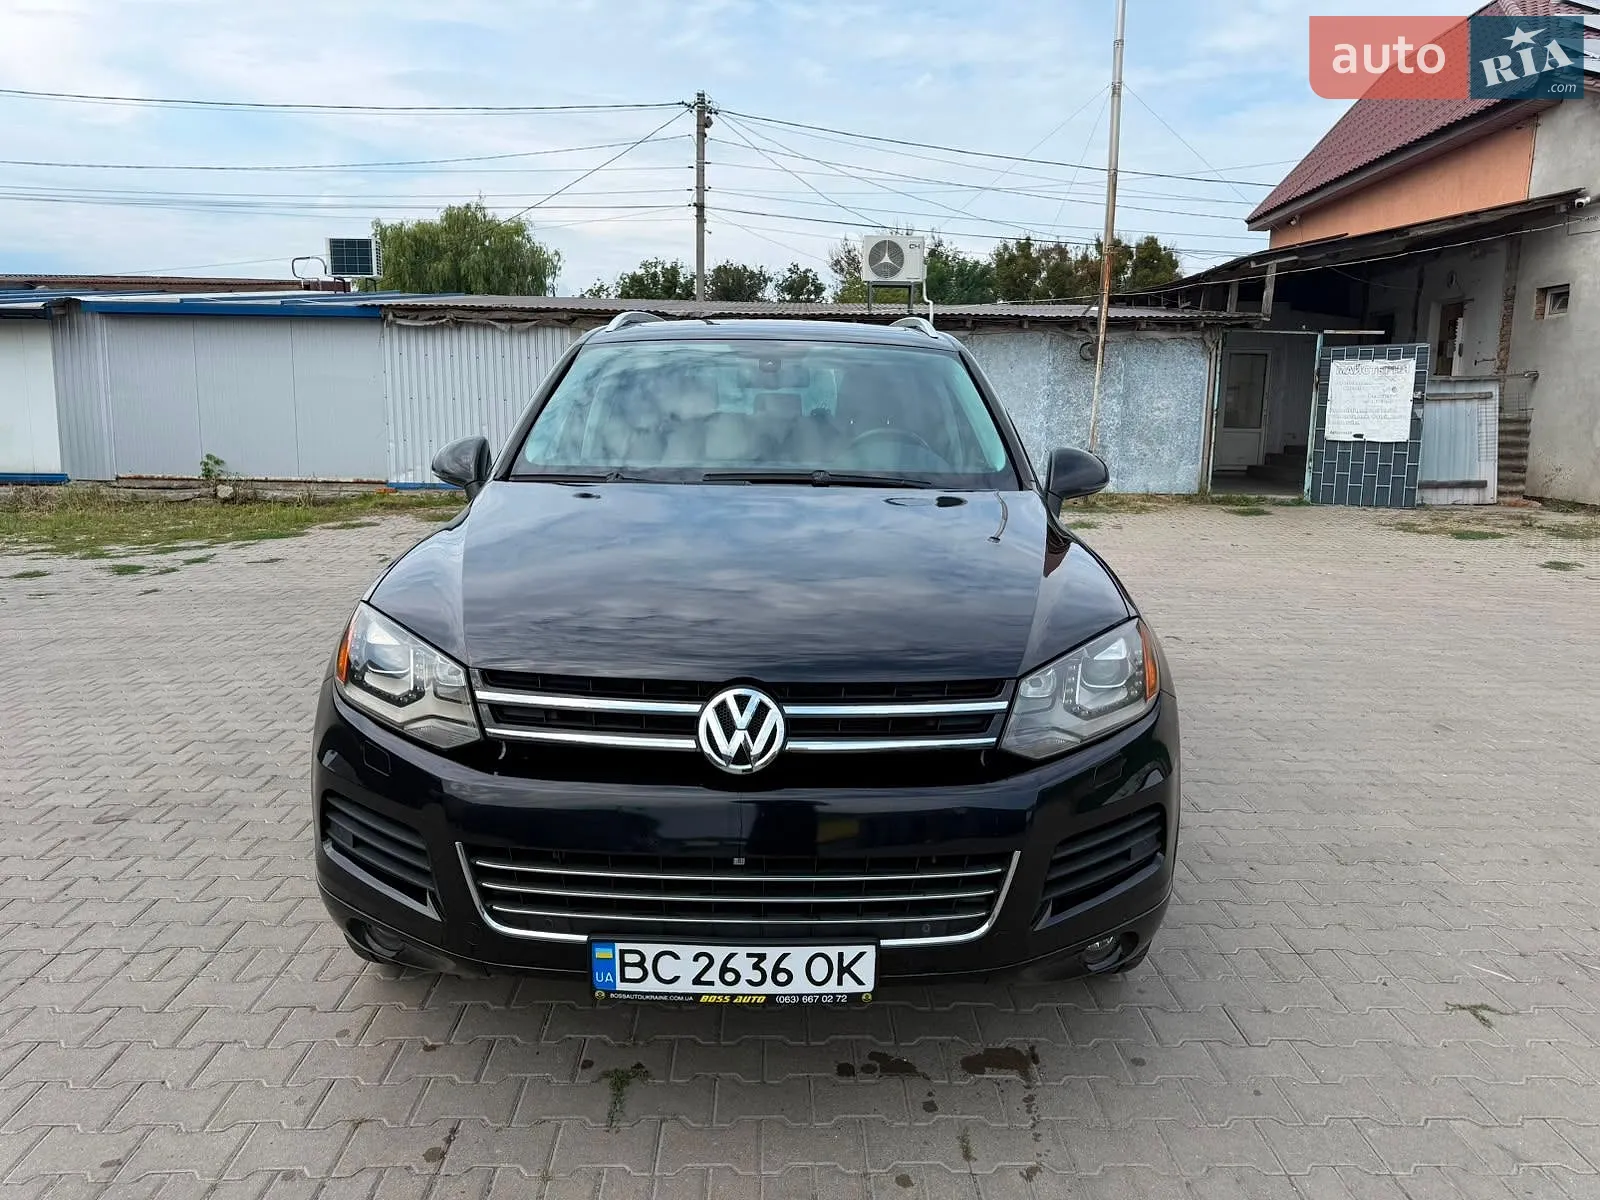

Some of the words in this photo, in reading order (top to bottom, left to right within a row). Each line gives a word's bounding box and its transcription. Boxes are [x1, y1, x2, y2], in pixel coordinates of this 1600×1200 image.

[618, 948, 681, 984] BC
[691, 951, 794, 986] 2636
[805, 951, 868, 987] OK
[595, 971, 614, 983] UA
[700, 995, 731, 1003] BOSS
[775, 995, 799, 1004] (063)
[802, 995, 820, 1003] 667
[821, 995, 834, 1003] 02
[835, 994, 848, 1002] 72
